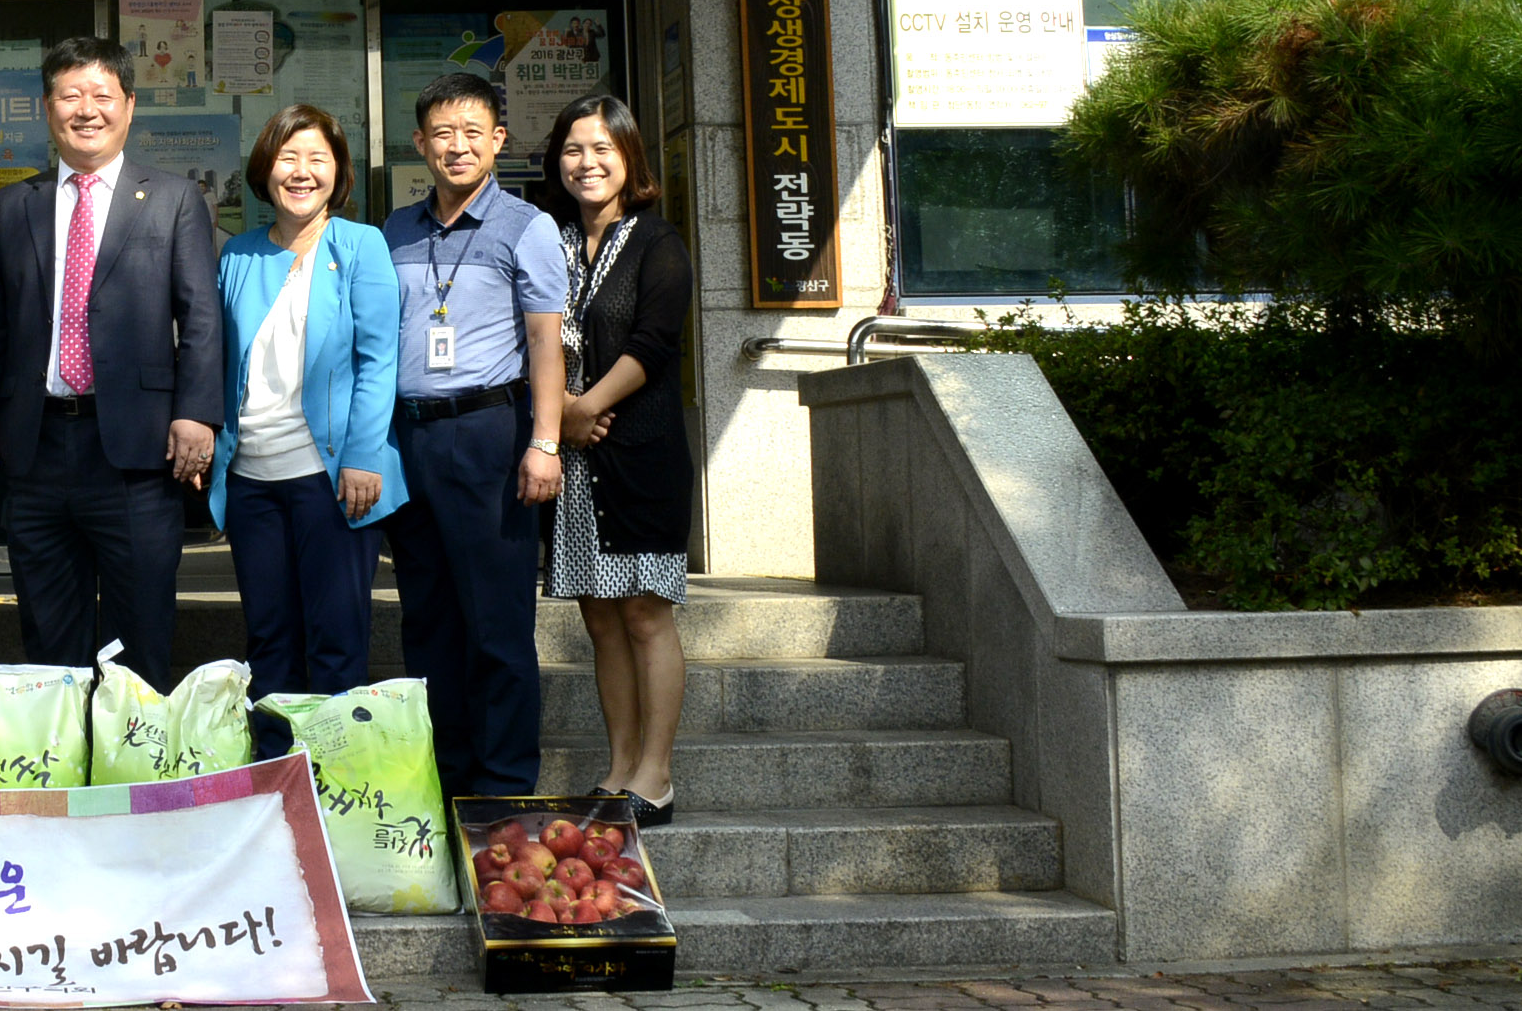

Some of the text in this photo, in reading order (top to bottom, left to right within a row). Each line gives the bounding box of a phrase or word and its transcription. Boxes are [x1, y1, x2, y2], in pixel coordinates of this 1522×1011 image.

[899, 10, 1075, 35] CCTV 설치 운영 안내
[530, 49, 585, 61] 2016 광산구
[516, 62, 600, 81] 취업 박람회
[773, 172, 816, 261] 전략동
[795, 278, 830, 293] 광산구
[89, 906, 284, 974] 바랍니다!
